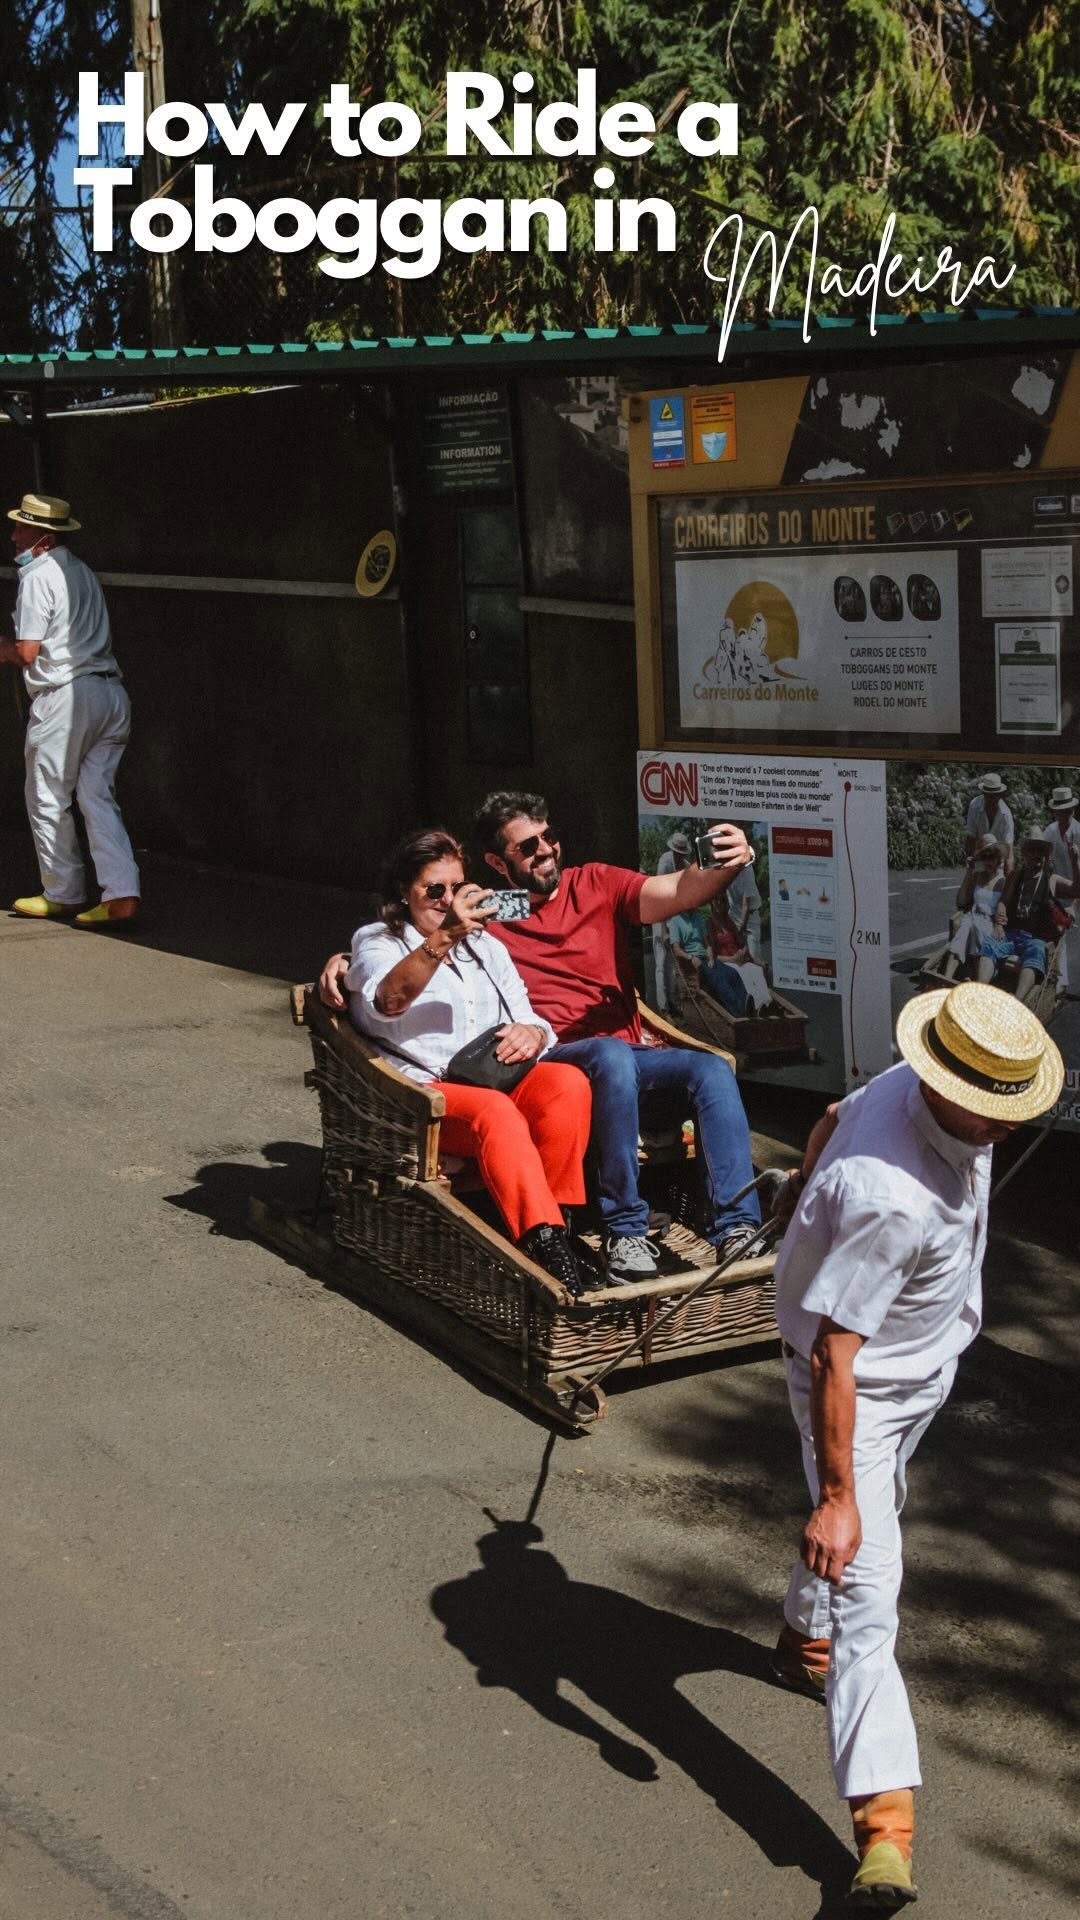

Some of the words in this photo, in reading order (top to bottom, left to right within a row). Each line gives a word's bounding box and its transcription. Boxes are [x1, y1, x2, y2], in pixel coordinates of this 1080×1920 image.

[439, 391, 498, 408] INFORMAÇÃO
[440, 445, 501, 460] INFORMATION
[674, 511, 769, 548] CARREIROS
[778, 509, 801, 544] DO
[812, 506, 877, 543] MONTE
[850, 647, 884, 658] CARROS
[885, 647, 897, 657] DE
[899, 647, 927, 658] CESTO
[841, 664, 891, 674] TOBOGGANS
[893, 664, 905, 674] DO
[907, 664, 938, 674] MONTE
[851, 680, 879, 691] LUGES
[880, 681, 893, 691] DO
[894, 681, 925, 691] MONTE
[692, 683, 752, 701] Carreiros
[754, 683, 772, 701] do
[775, 683, 819, 702] Monte
[853, 697, 881, 708] RODEL
[883, 697, 895, 708] DO
[897, 697, 928, 708] MONTE
[723, 765, 733, 773] the
[763, 767, 786, 775] coolest
[838, 770, 858, 778] MONTE
[640, 761, 698, 807] CNN
[715, 776, 726, 784] dos
[788, 780, 796, 788] do
[761, 801, 785, 810] Fahrten
[786, 803, 792, 811] in
[857, 930, 863, 944] 2
[865, 931, 881, 946] KM
